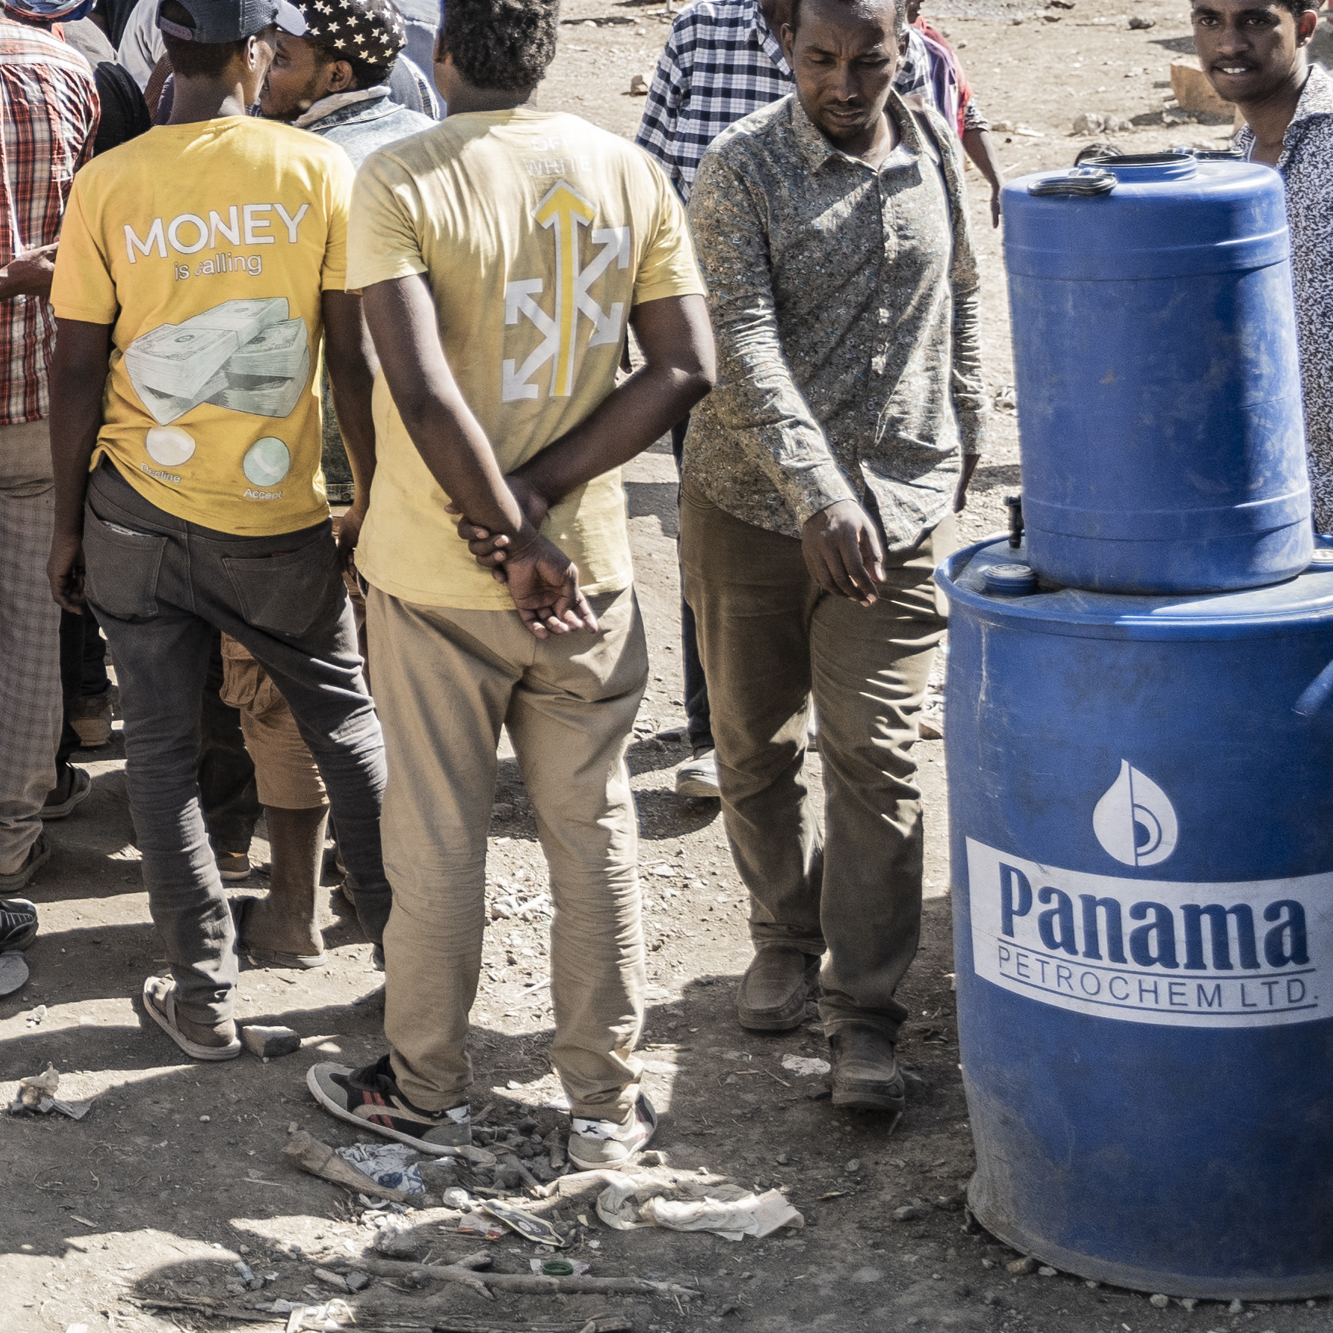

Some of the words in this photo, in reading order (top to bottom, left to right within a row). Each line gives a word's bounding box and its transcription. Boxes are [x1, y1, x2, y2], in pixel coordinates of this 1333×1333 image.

[123, 203, 310, 264] MONEY
[174, 261, 190, 281] is
[194, 252, 262, 277] calling
[139, 462, 182, 484] Decline
[242, 488, 283, 501] Accept
[998, 861, 1311, 971] Panama
[997, 945, 1224, 1009] PETROCHEM
